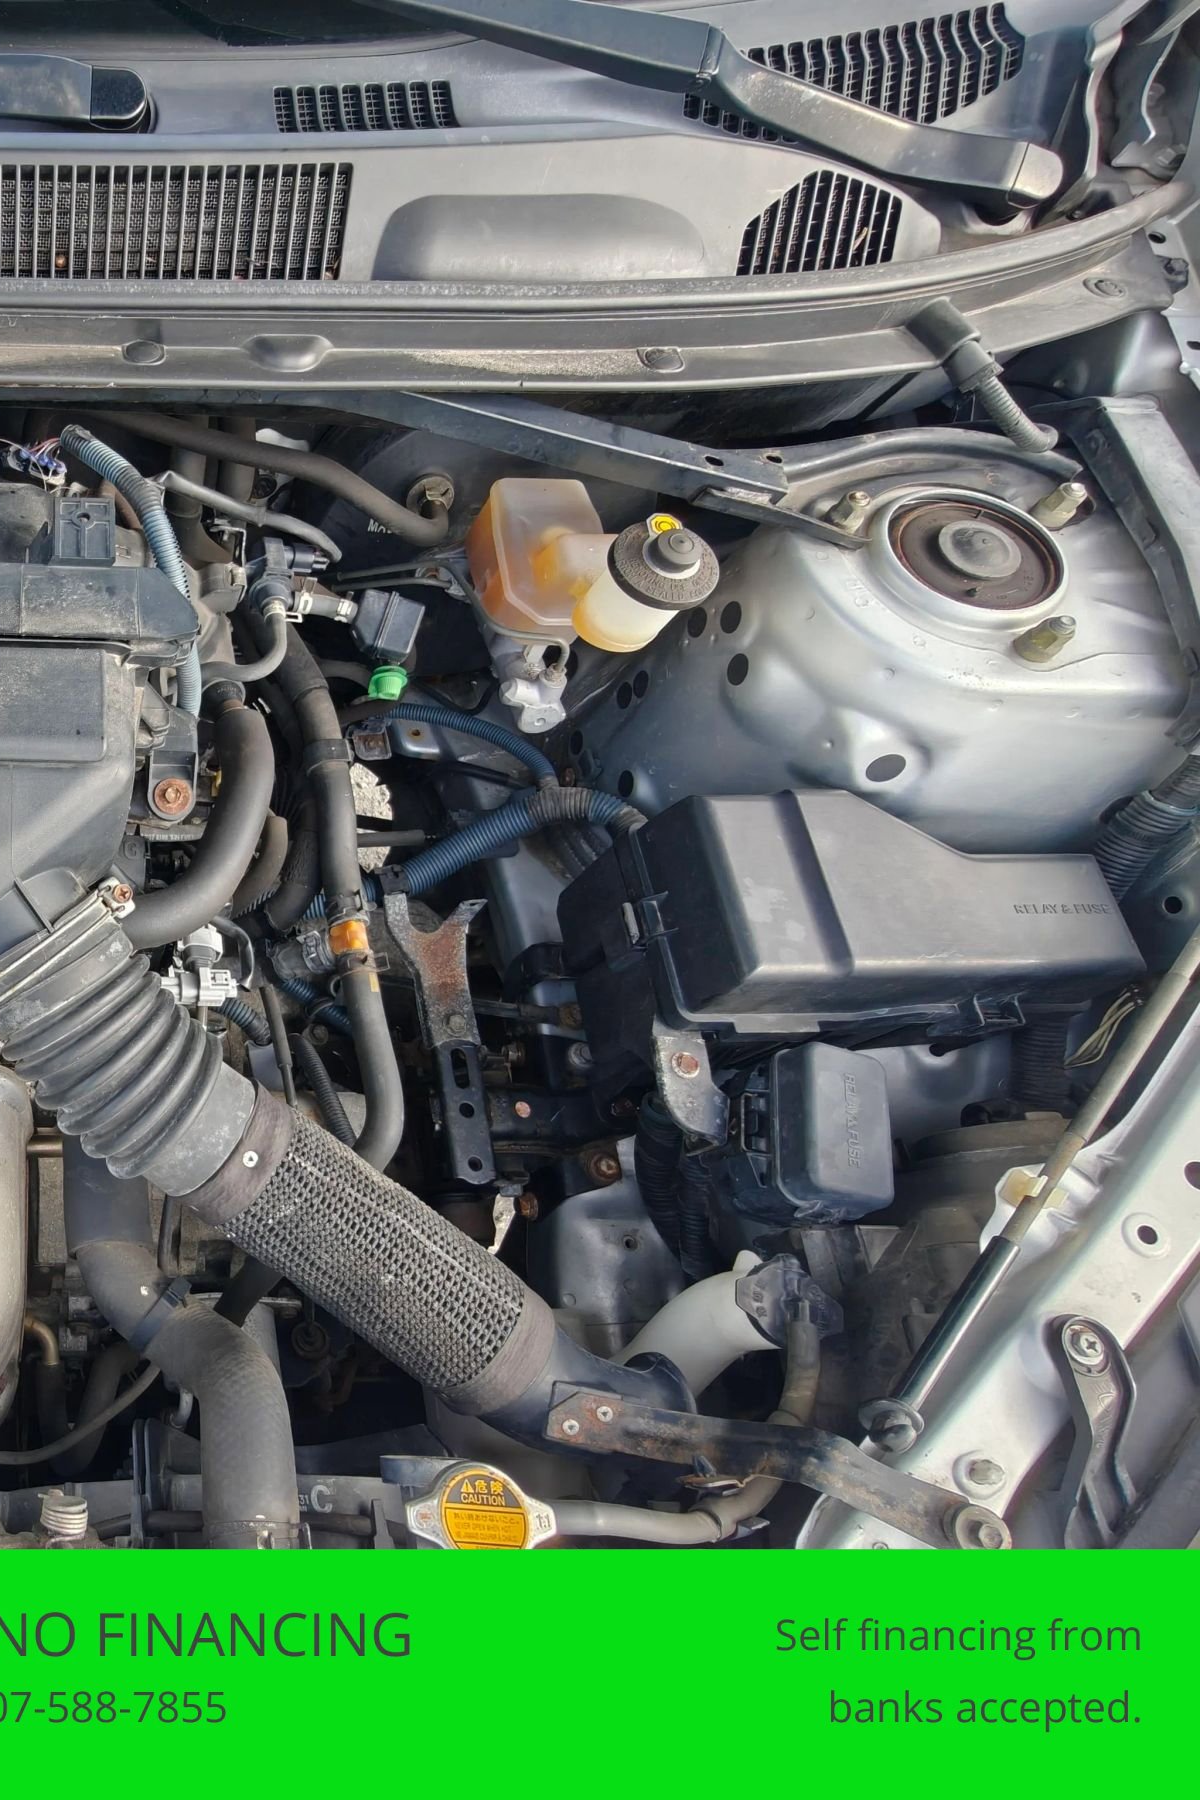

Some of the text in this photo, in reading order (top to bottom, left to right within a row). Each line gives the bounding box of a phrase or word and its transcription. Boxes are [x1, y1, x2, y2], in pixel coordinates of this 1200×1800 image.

[1013, 903, 1113, 915] RELAY & FUSE
[848, 1129, 861, 1168] FUSE
[310, 1484, 333, 1513] C
[460, 1493, 506, 1506] CAUTION
